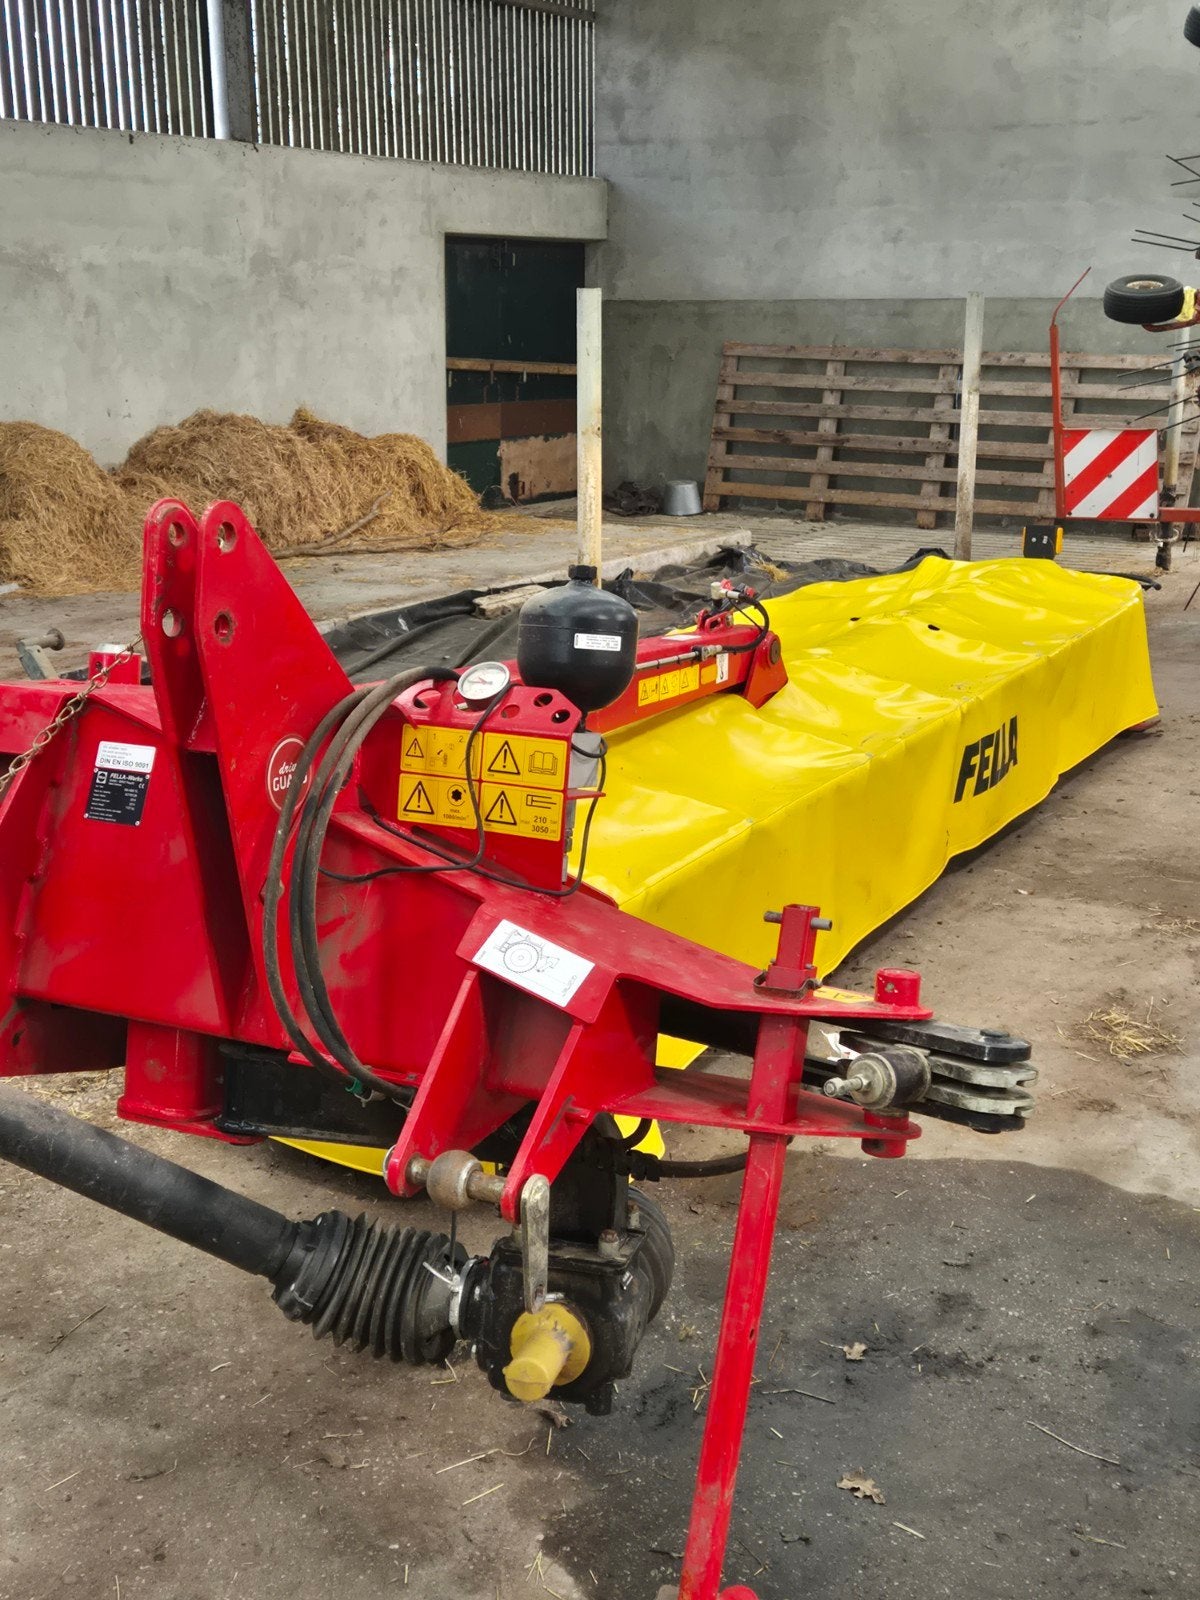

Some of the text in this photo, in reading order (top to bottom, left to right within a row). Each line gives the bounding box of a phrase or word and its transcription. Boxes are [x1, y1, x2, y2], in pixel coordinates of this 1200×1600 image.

[99, 757, 111, 765] DIN
[112, 758, 121, 766] EN
[953, 714, 1019, 804] FELLA
[533, 815, 547, 824] 210
[531, 824, 549, 834] 3050
